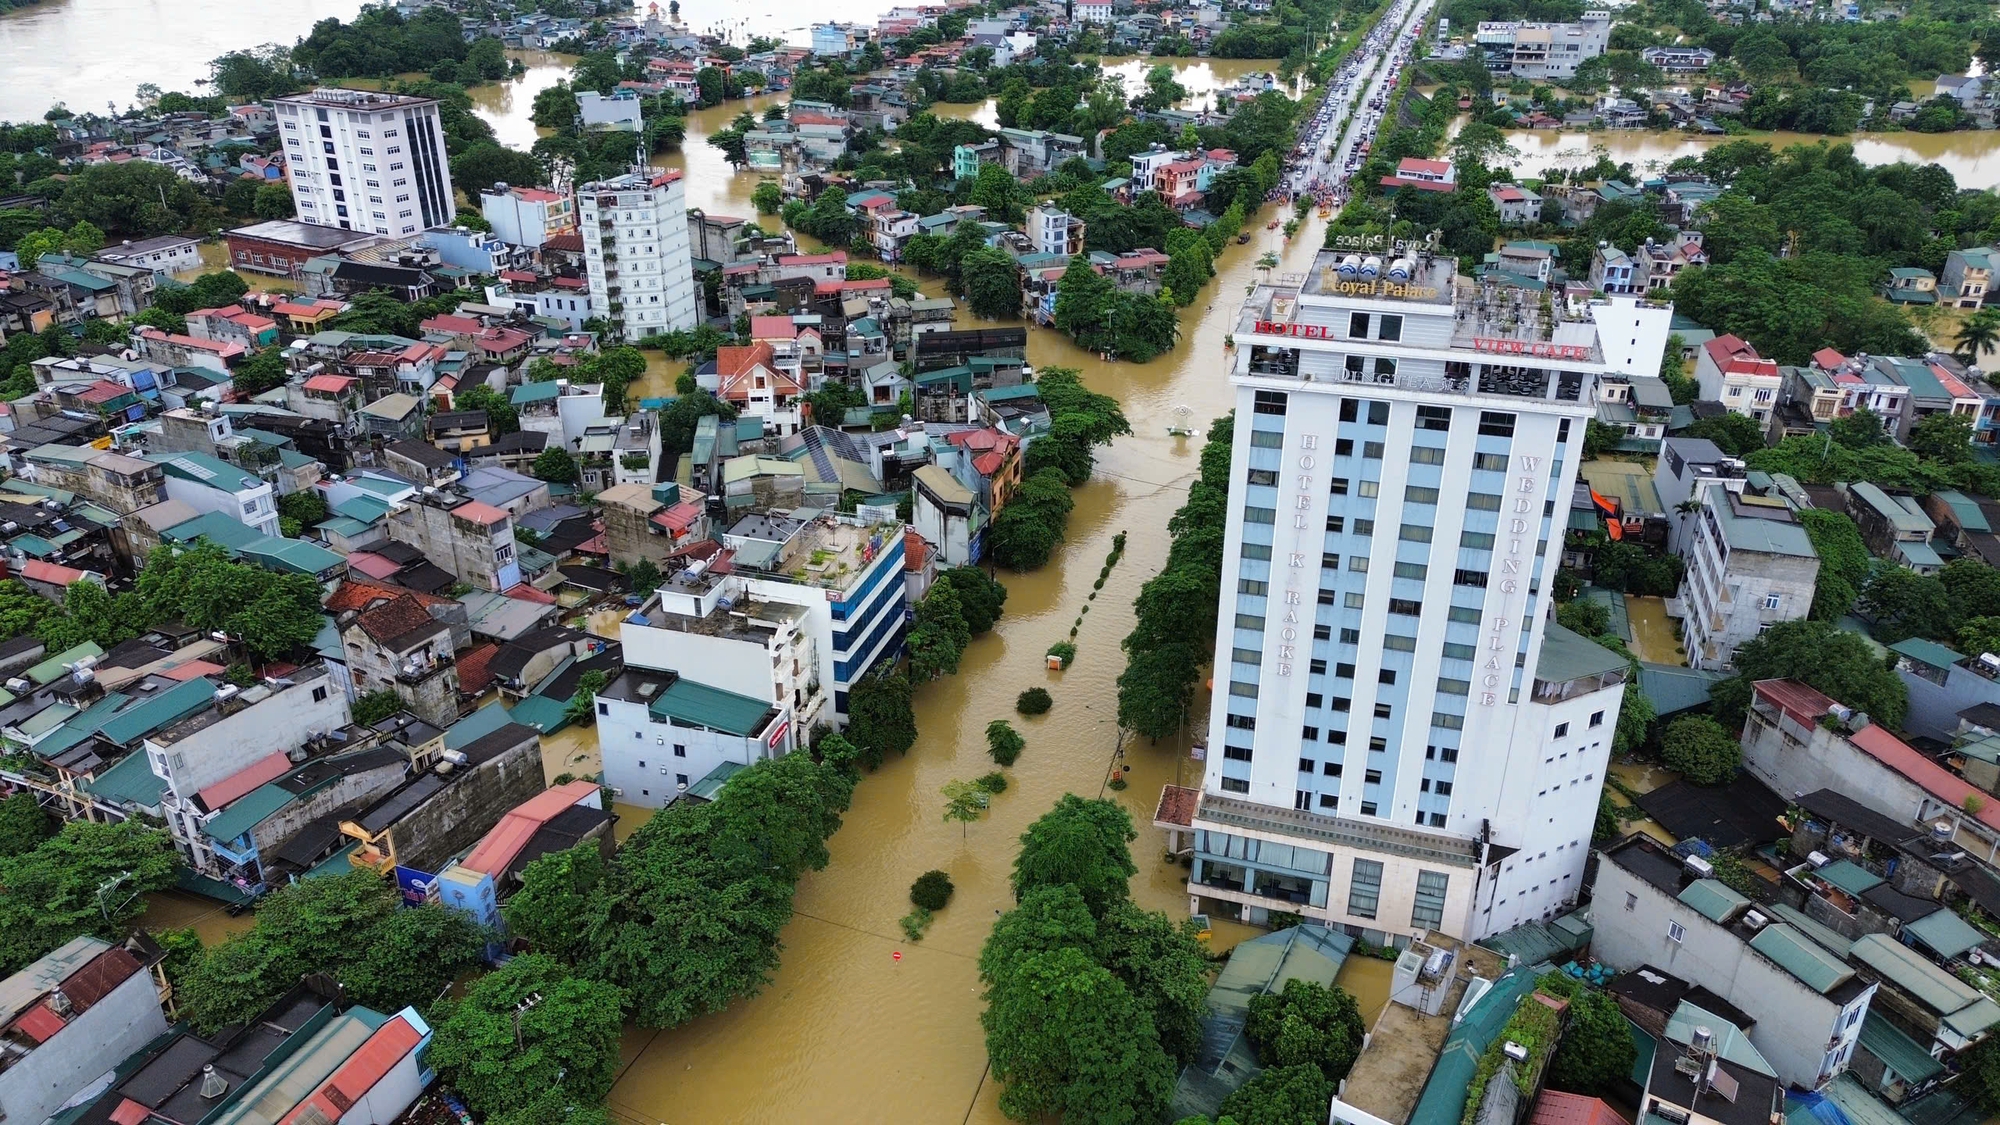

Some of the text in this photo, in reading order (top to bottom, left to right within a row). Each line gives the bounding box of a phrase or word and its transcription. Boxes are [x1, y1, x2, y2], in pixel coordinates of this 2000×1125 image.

[1383, 280, 1438, 299] Palace
[1253, 321, 1334, 339] HOTEL
[1473, 337, 1589, 361] VIEW CAFE
[1294, 434, 1318, 530] HOTEL
[1480, 456, 1541, 707] WEDDING PLACE
